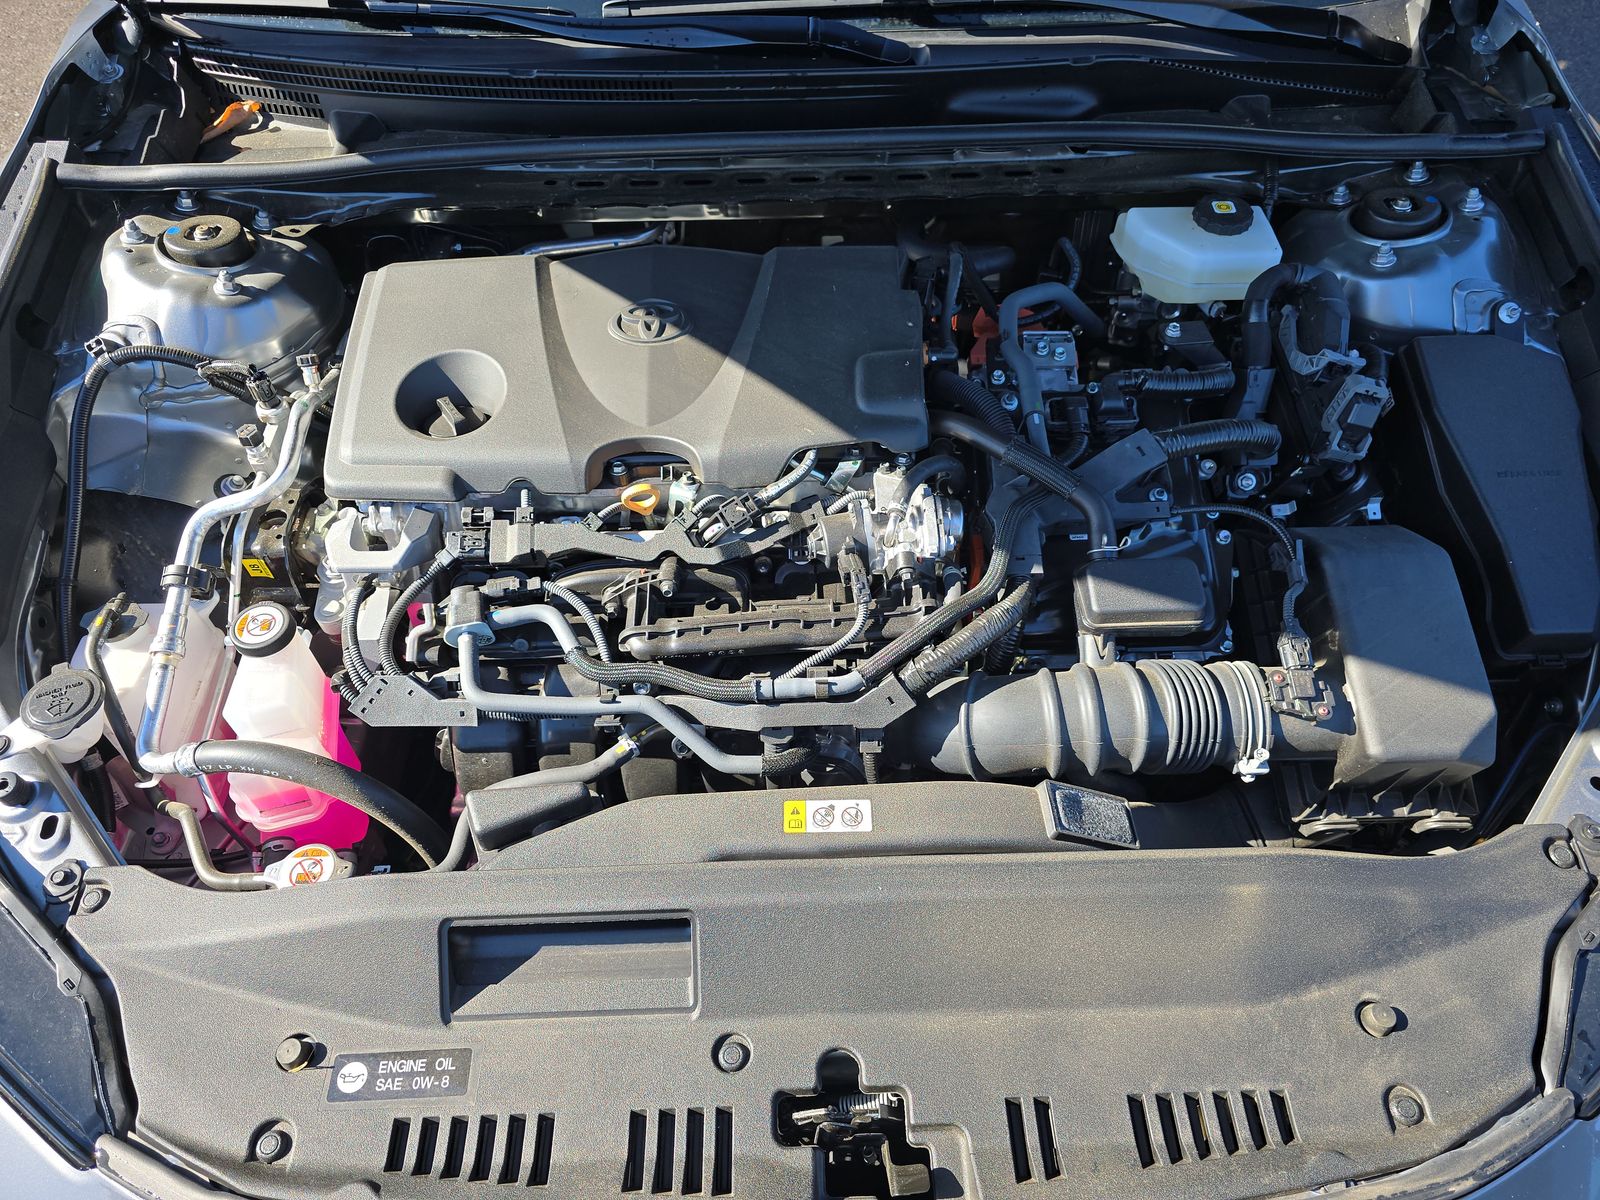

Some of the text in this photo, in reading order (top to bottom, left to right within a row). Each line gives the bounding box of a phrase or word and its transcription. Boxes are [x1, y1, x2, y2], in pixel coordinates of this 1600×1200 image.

[378, 1057, 456, 1074] ENGINE OIL
[375, 1075, 450, 1092] SAE 0W-8
